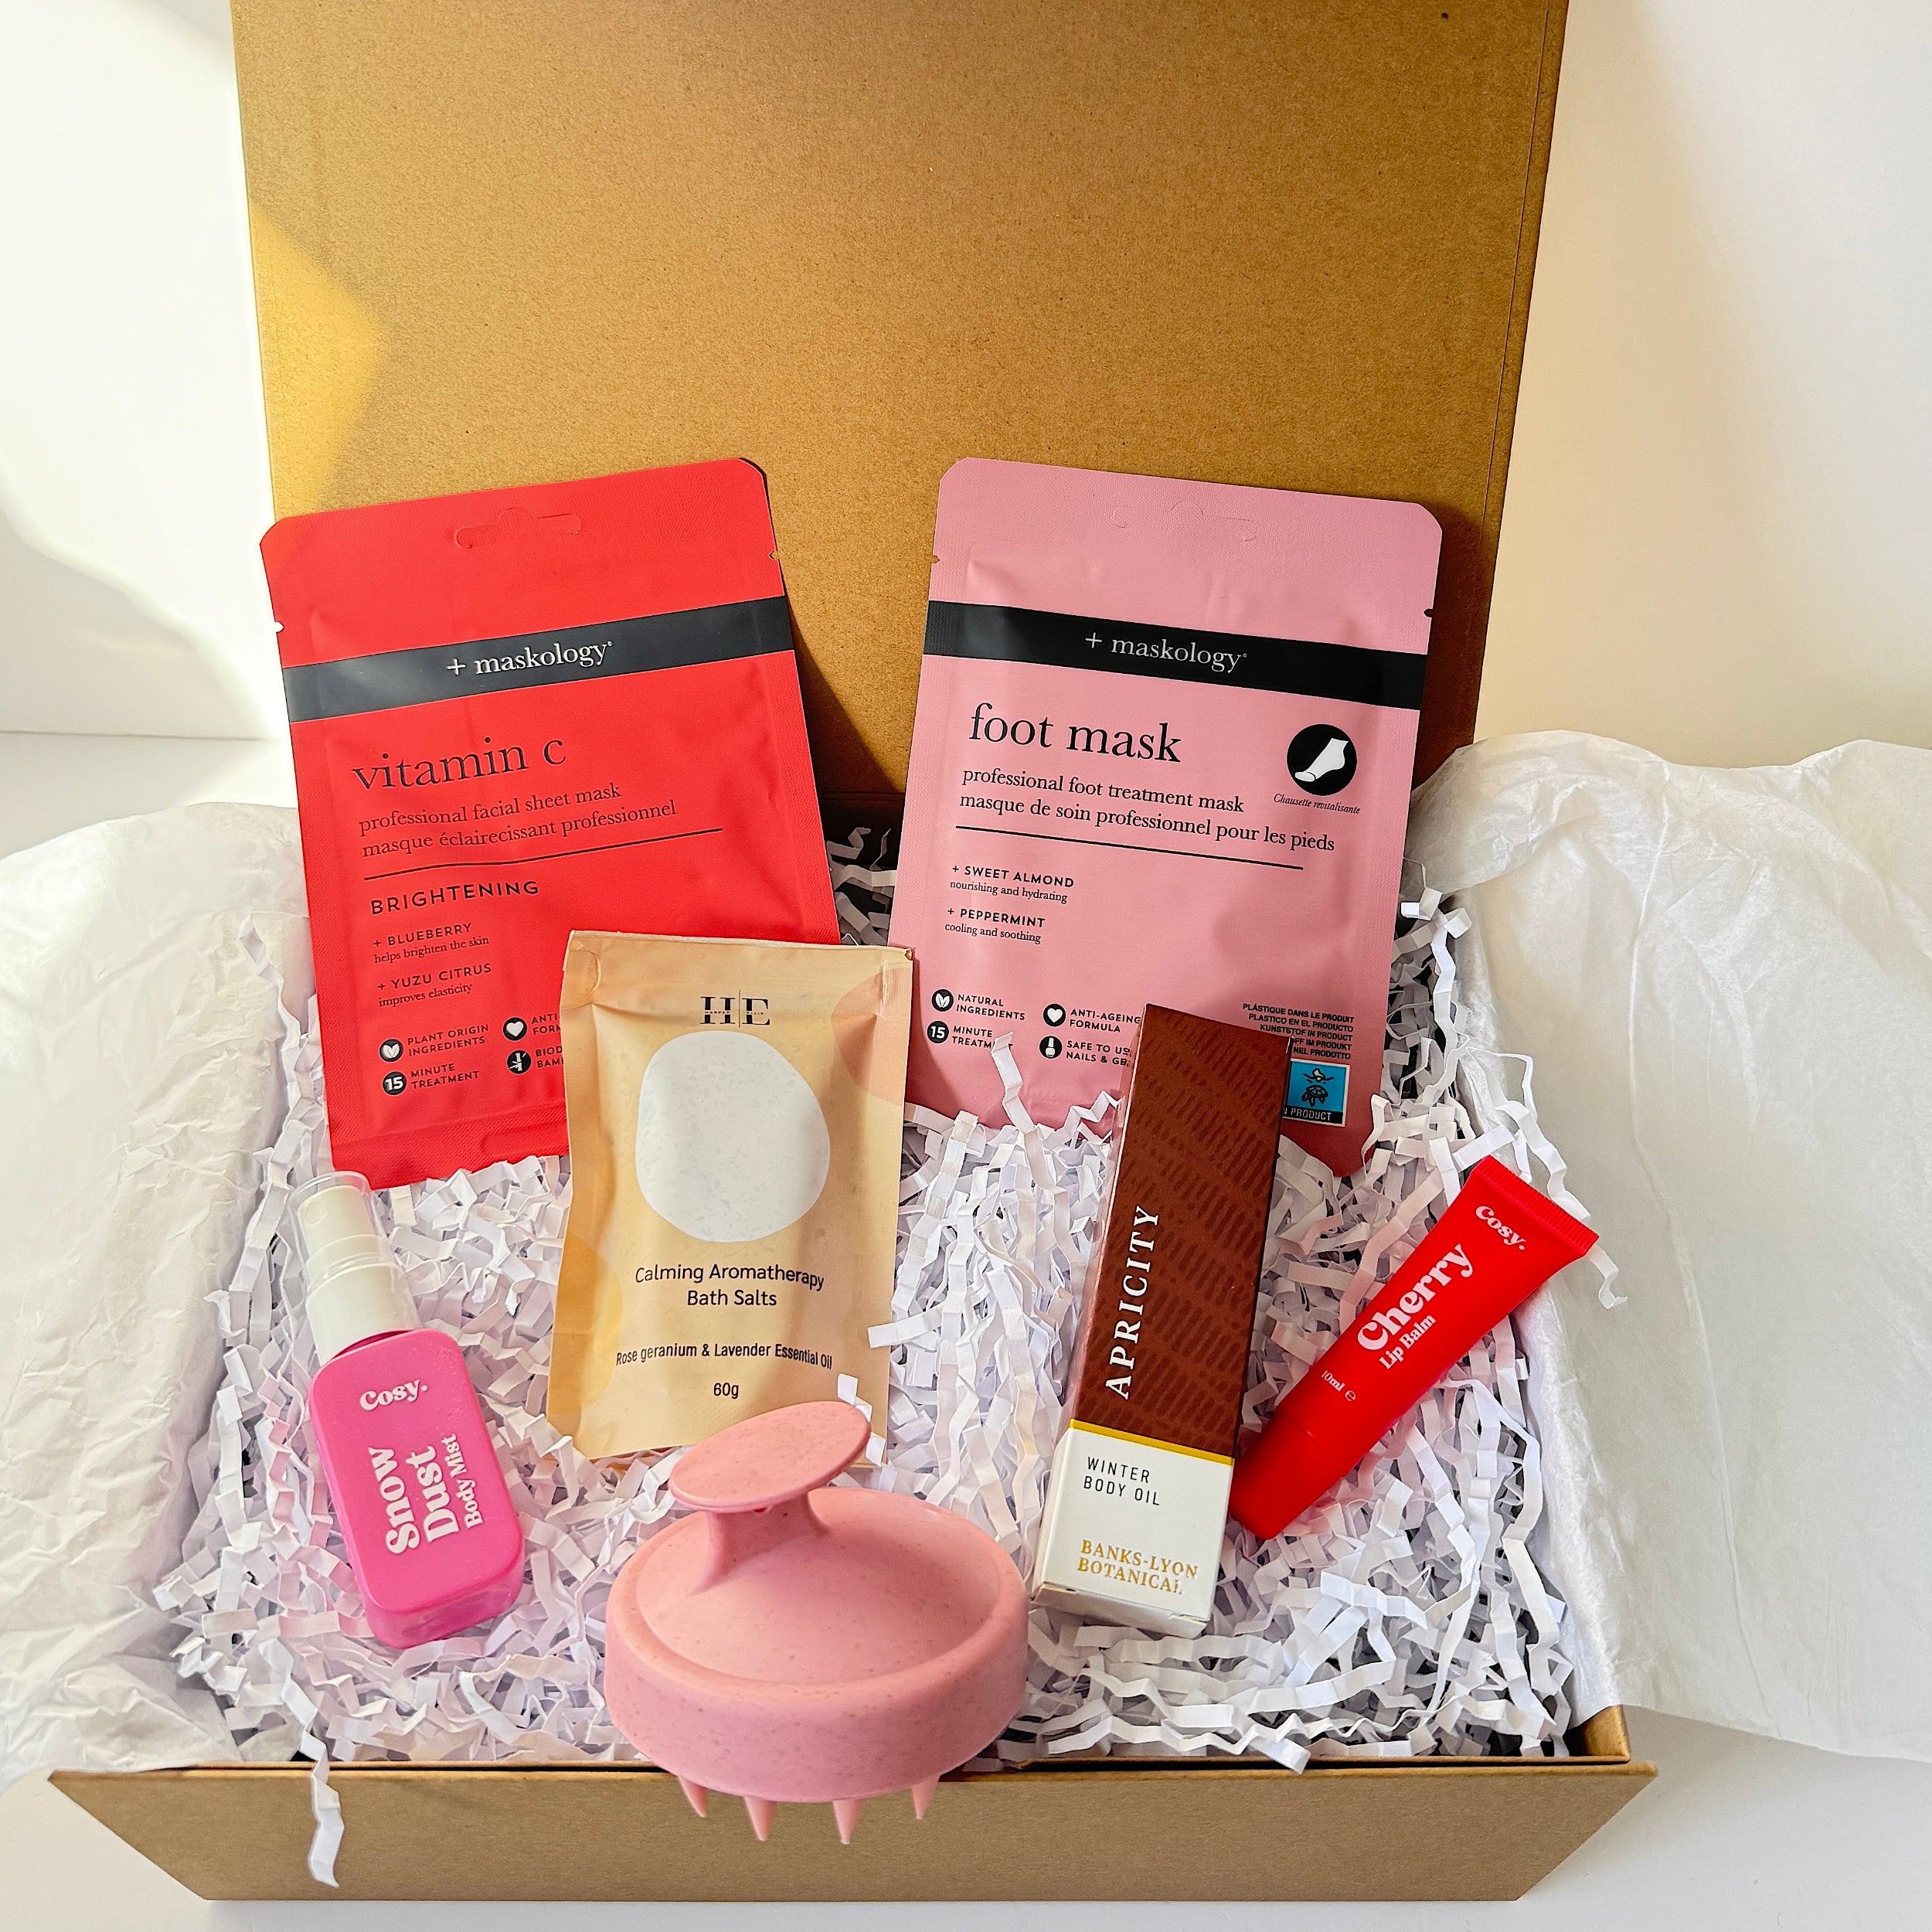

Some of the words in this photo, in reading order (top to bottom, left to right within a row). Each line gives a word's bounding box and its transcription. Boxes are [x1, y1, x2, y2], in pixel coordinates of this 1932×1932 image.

[968, 702, 1053, 748] foot
[1066, 723, 1182, 763] mask
[352, 737, 529, 789] vitamin
[543, 740, 566, 764] c
[962, 767, 1063, 791] professional
[1068, 777, 1104, 796] foot
[1108, 784, 1194, 807] treatment
[1198, 796, 1244, 813] mask
[359, 807, 468, 836] professional
[474, 798, 519, 819] facial
[526, 795, 570, 811] sheet
[576, 782, 621, 803] mask
[362, 836, 433, 856] masque
[440, 822, 556, 845] éclairecissant
[561, 799, 676, 837] professionnel
[960, 795, 1025, 815] masque
[1030, 799, 1051, 816] de
[1056, 804, 1091, 821] soin
[1095, 810, 1211, 835] professionnel
[1215, 825, 1260, 841] pour
[1264, 826, 1286, 844] les
[1290, 832, 1335, 851] pieds
[964, 866, 1009, 879] SWEET
[1013, 872, 1074, 888] ALMOND
[371, 881, 539, 914] BRIGHTENING
[950, 881, 998, 896] nourishing
[1001, 887, 1019, 896] and
[1022, 887, 1068, 904] hydrating
[960, 908, 1046, 928] PEPPERMINT
[388, 923, 471, 945] BLUEBERRY
[944, 923, 978, 937] cooling
[980, 928, 998, 937] and
[1000, 930, 1042, 945] soothing
[374, 953, 400, 964] helps
[403, 945, 447, 958] brighten
[451, 940, 466, 950] the
[469, 936, 489, 947] skin
[391, 974, 432, 988] YUZU
[439, 963, 492, 981] CITRUS
[379, 992, 426, 1007] improves
[429, 984, 472, 998] elasticity
[958, 994, 1004, 1006] NATURAL
[956, 1005, 1025, 1020] INGREDIENTS
[1070, 1009, 1141, 1023] ANTI-AGEING
[1287, 1009, 1308, 1018] DANS
[1322, 1013, 1354, 1023] PRODUIT
[407, 1032, 444, 1045] PLANT
[447, 1024, 488, 1038] ORIGIN
[930, 1026, 945, 1039] 15
[953, 1026, 993, 1037] MINUTE
[1070, 1019, 1121, 1032] FORMULA
[1260, 1024, 1306, 1036] KUNSTSTOF
[1317, 1031, 1353, 1042] PRODUCT
[1312, 1022, 1353, 1032] PRODUCTO
[409, 1036, 485, 1056] INGREDIENTS
[952, 1036, 1013, 1050] TREATMT
[1067, 1040, 1092, 1050] SAFE
[1096, 1044, 1111, 1053] TO
[1316, 1040, 1352, 1051] PRODUKT
[537, 1057, 563, 1068] BAM
[1066, 1051, 1096, 1061] NAILS
[1310, 1049, 1351, 1060] PRODOTTO
[411, 1063, 454, 1078] MINUTE
[411, 1070, 479, 1090] TREATMENT
[385, 1077, 403, 1090] 15
[1291, 1107, 1332, 1121] PRODUCT
[1475, 1206, 1526, 1250] Cosy.
[635, 1264, 704, 1283] Calming
[709, 1264, 824, 1292] Aromatherapy
[687, 1289, 728, 1306] Bath
[734, 1289, 777, 1306] Salts
[1105, 1205, 1158, 1400] APRICITY
[1356, 1243, 1475, 1351] Cherry
[1378, 1345, 1404, 1370] Lip
[1399, 1313, 1437, 1349] Balm
[616, 1352, 638, 1366] Rose
[641, 1343, 697, 1362] geranium
[701, 1343, 710, 1356] &
[715, 1343, 771, 1357] Lavender
[775, 1343, 818, 1366] Essential
[821, 1353, 832, 1369] Oil
[713, 1383, 740, 1399] 60g
[1321, 1370, 1345, 1392] 10ml
[359, 1379, 428, 1410] Cosy.
[441, 1433, 468, 1478] Mist
[1087, 1457, 1150, 1483] WINTER
[368, 1447, 420, 1554] Snow
[406, 1445, 460, 1543] Dust
[1083, 1476, 1126, 1496] BODY
[1134, 1488, 1160, 1505] OIL
[456, 1478, 483, 1529] Body
[1080, 1539, 1199, 1579] BANKS-LYON
[1077, 1557, 1182, 1595] BOTANICAL
